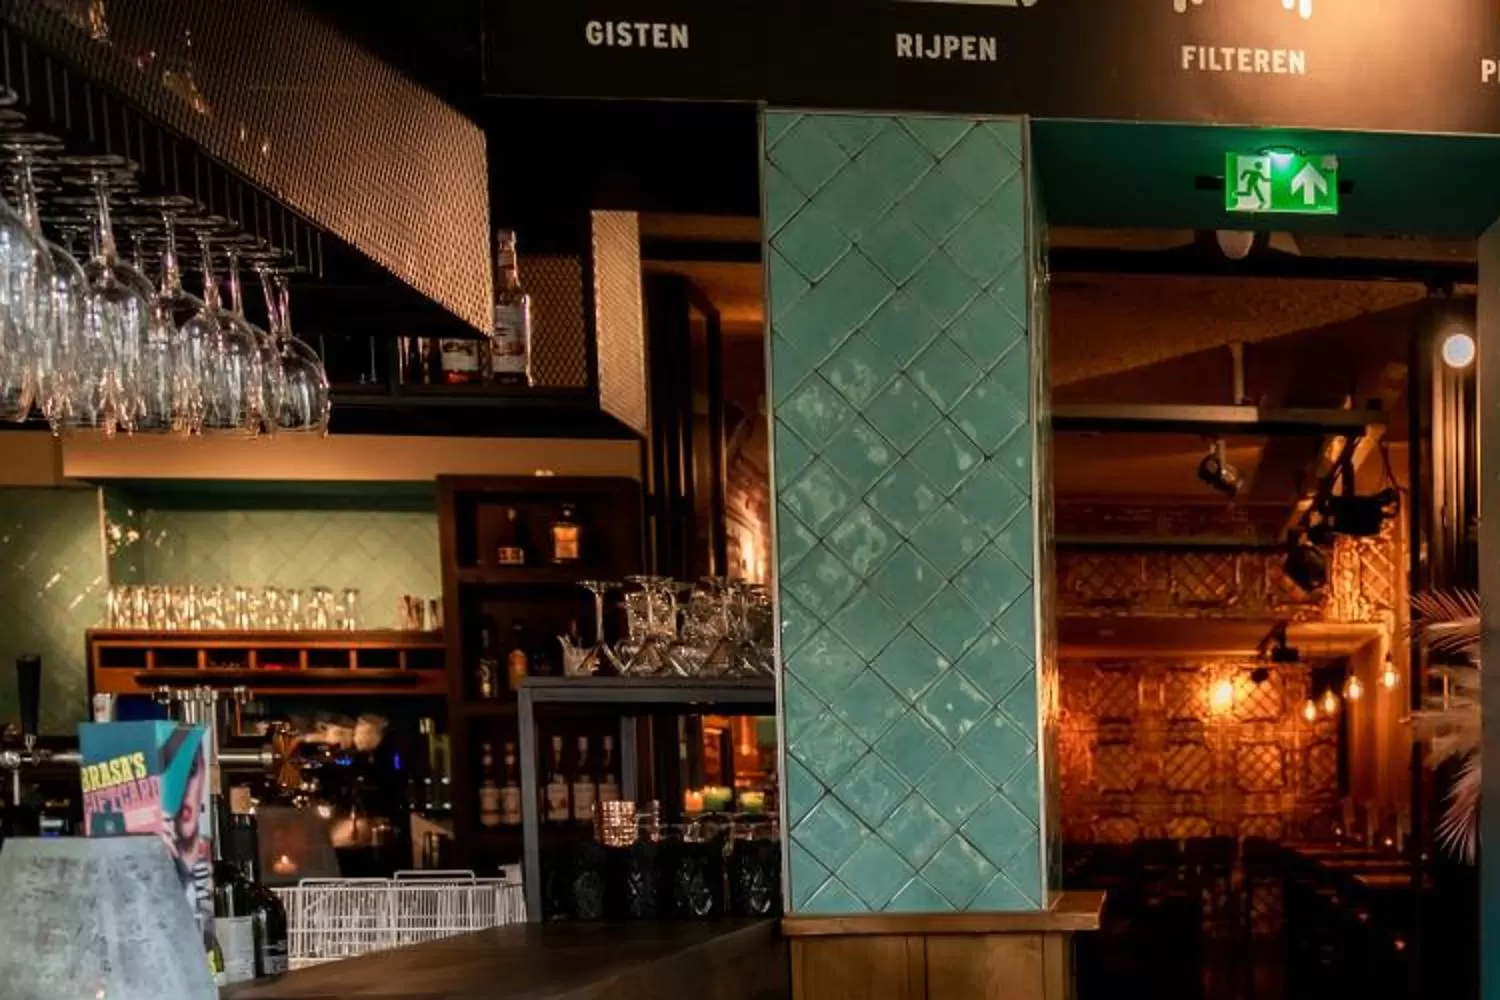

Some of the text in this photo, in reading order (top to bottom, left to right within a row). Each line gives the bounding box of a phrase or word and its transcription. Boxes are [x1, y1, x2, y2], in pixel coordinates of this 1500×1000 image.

[585, 20, 690, 48] GISTEN
[896, 33, 998, 61] RIJPEN
[1181, 45, 1306, 75] FILTEREN
